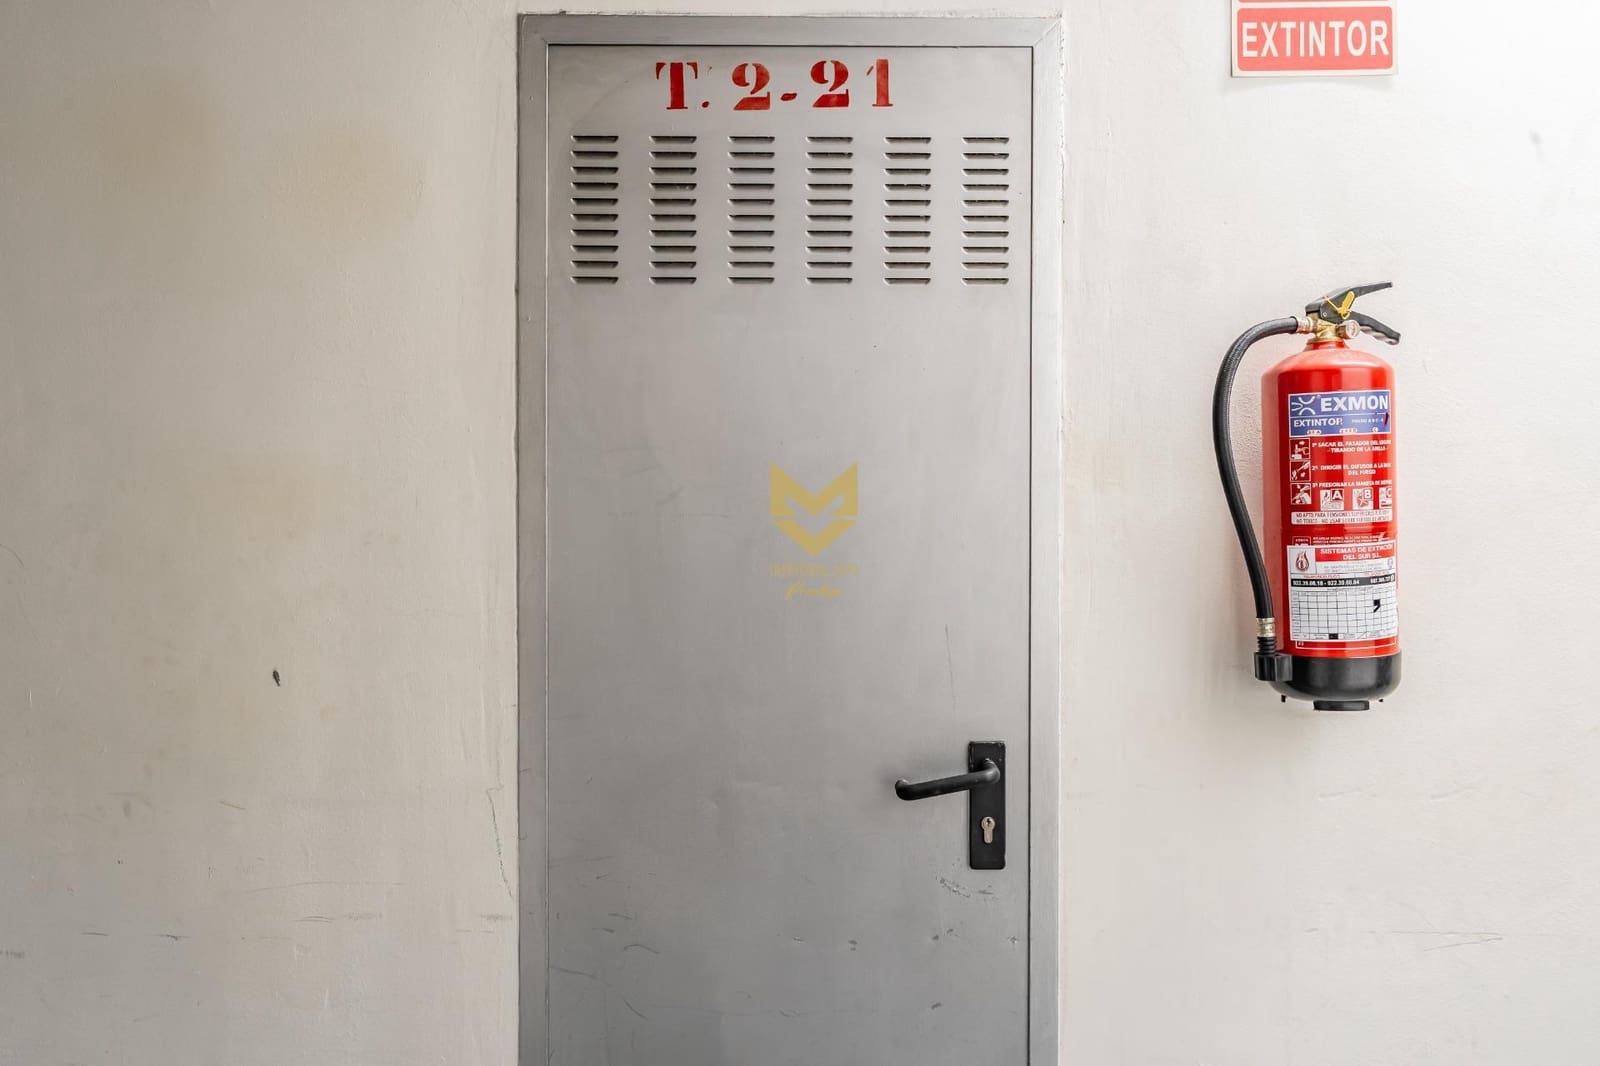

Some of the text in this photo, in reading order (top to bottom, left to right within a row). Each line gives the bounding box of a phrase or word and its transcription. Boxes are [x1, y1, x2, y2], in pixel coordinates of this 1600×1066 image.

[1242, 20, 1389, 57] EXTINTOR
[1321, 395, 1388, 412] EXMON
[1294, 418, 1343, 427] EXTINTOR
[1333, 490, 1342, 499] A
[1364, 489, 1371, 499] B
[1320, 546, 1356, 554] SISTEMAS
